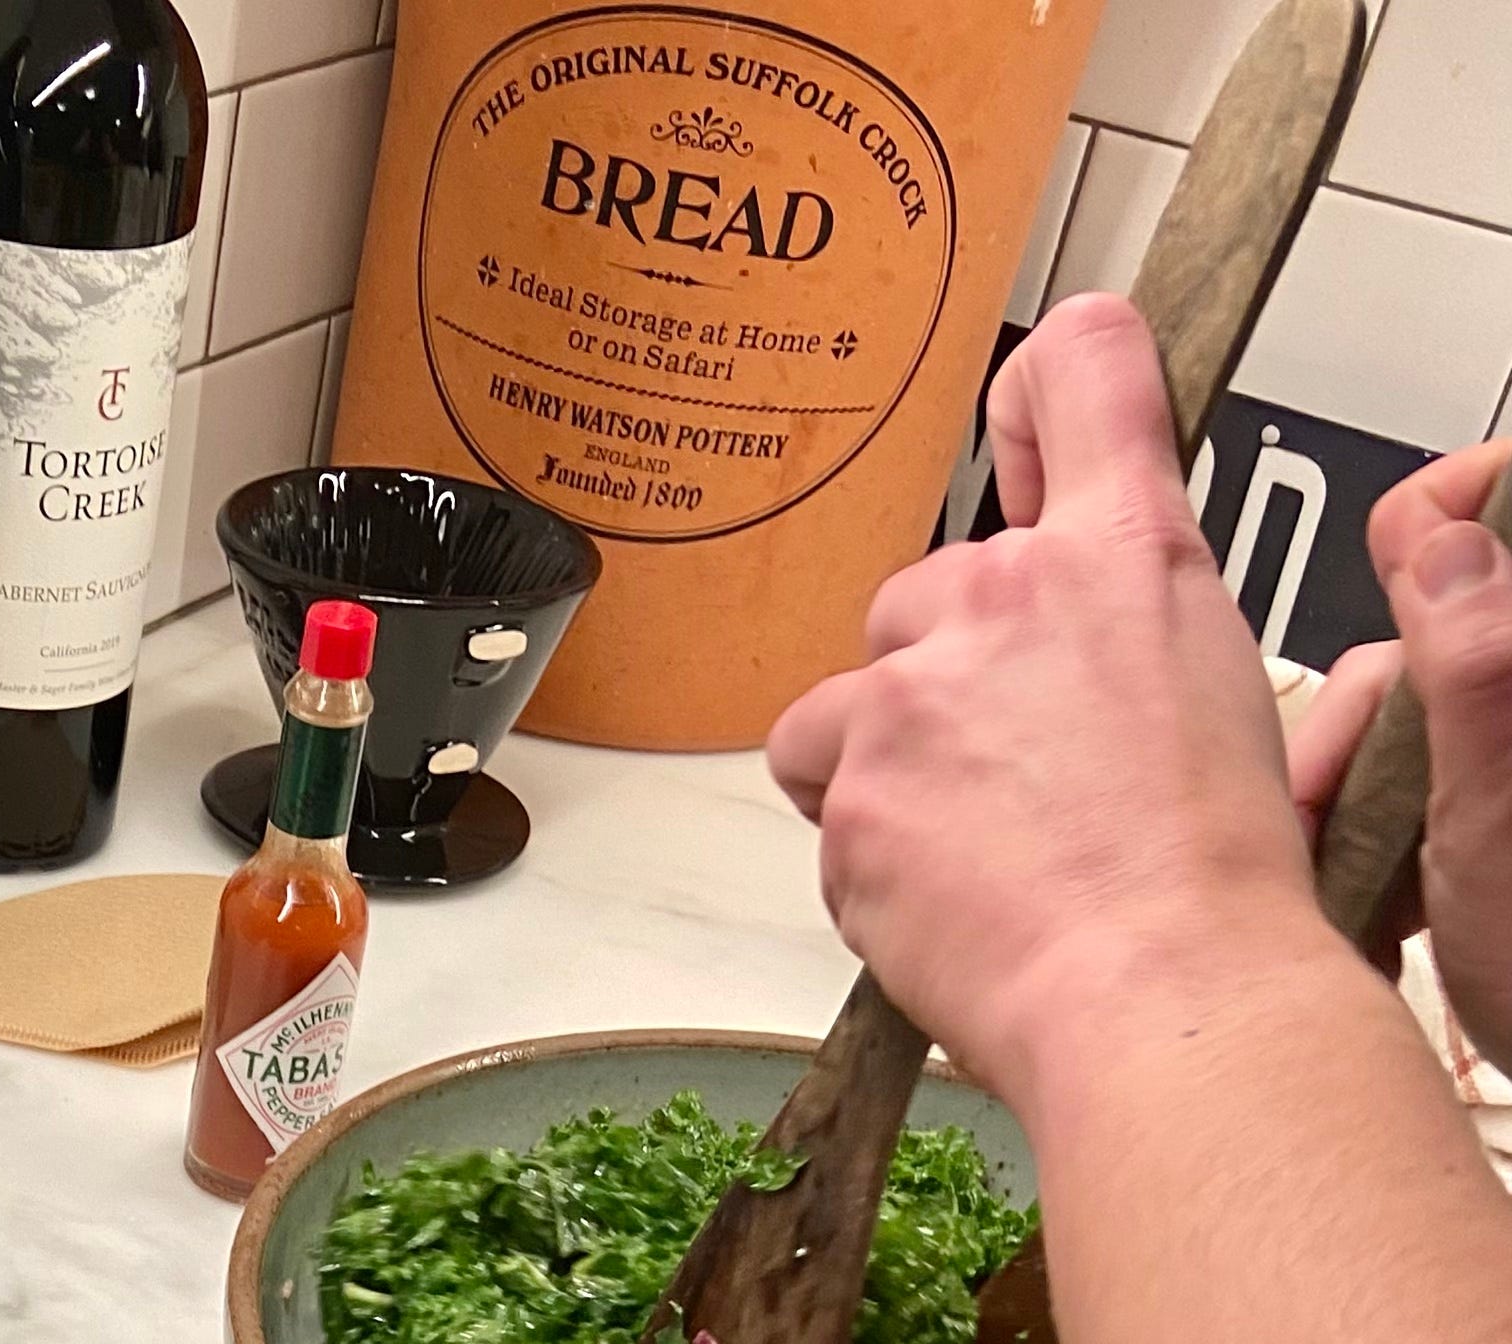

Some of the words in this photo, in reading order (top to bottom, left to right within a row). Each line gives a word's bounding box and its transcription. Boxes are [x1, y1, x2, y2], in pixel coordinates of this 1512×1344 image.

[472, 79, 525, 137] THE
[530, 45, 695, 92] ORIGINAL
[705, 52, 860, 134] SUFFOLK
[859, 123, 927, 230] CROCK
[541, 138, 835, 263] BREAD
[508, 266, 574, 312] Ideal
[579, 292, 693, 343] Storage
[701, 321, 729, 347] at
[736, 324, 822, 354] Home
[568, 329, 598, 354] or
[602, 338, 637, 364] on
[643, 344, 735, 381] Safari
[489, 373, 568, 422] HENRY
[570, 400, 670, 447] WATSON
[675, 424, 789, 459] POTTERY
[12, 429, 167, 480] TORTOISE
[583, 442, 671, 475] ENGLAND
[38, 480, 146, 522] CREEK
[536, 453, 637, 502] Founded
[643, 479, 704, 512] 1800
[39, 642, 99, 659] California
